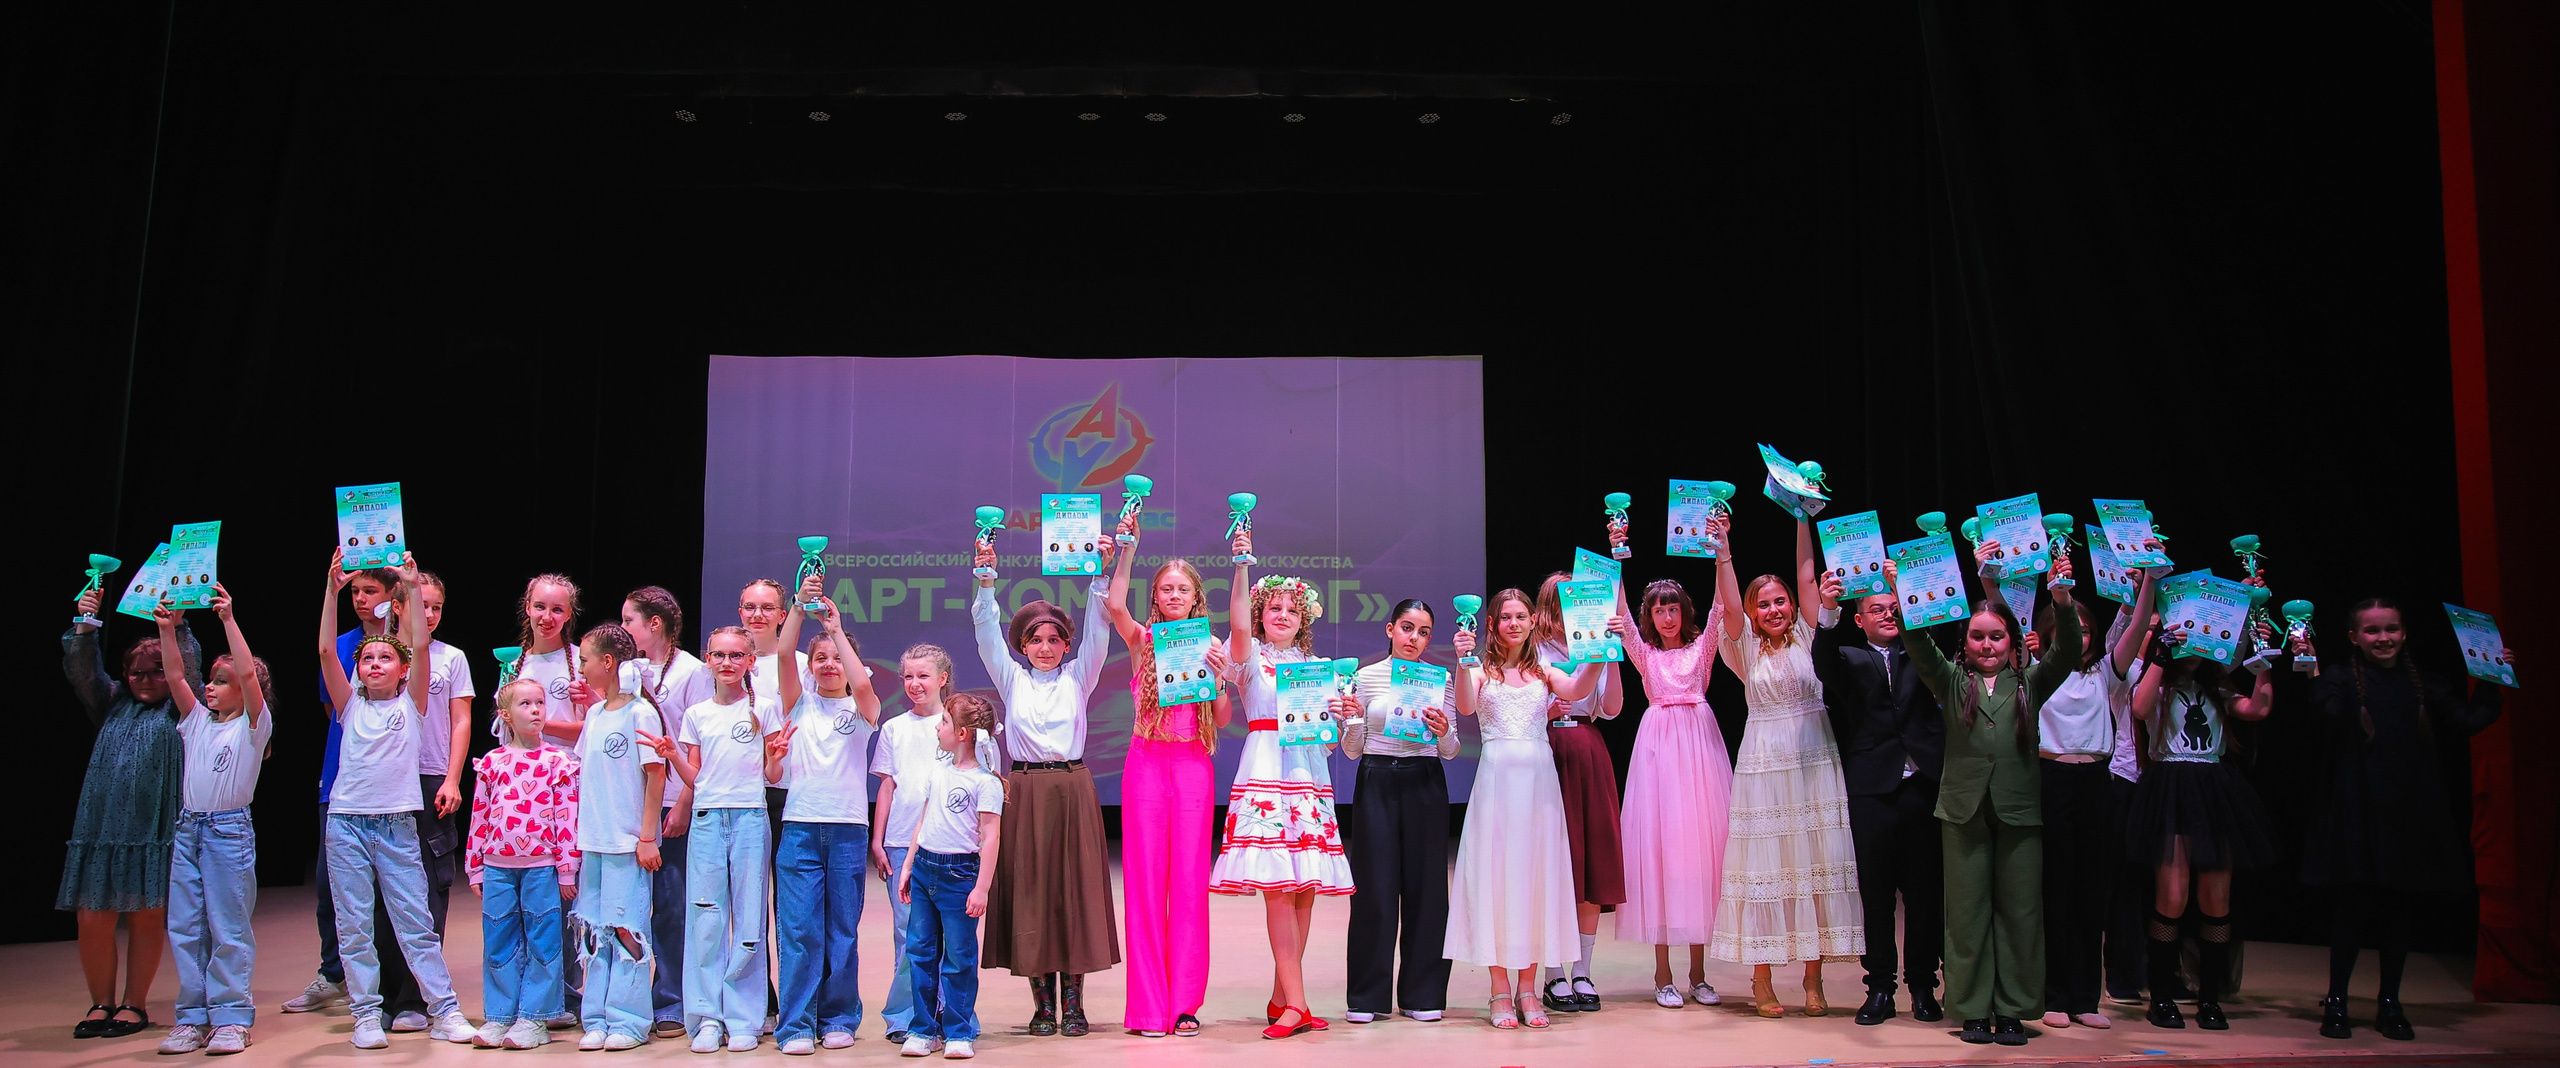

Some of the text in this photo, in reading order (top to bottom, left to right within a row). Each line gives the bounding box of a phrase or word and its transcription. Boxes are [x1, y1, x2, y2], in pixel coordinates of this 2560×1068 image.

[352, 502, 388, 513] ДИПЛОМ
[1055, 511, 1089, 520] ДИПЛОМ
[1994, 513, 2029, 528] ДИПЛОМ
[1834, 531, 1869, 544] ДИПЛОМ
[824, 551, 971, 568] ВСЕРОССИЙСКИЙ
[1257, 556, 1354, 568] ИСКУССТВА
[1906, 554, 1942, 571] ДИПЛОМ
[2199, 591, 2237, 608] ДИПЛОМ
[1166, 638, 1199, 650] ДИПЛОМ
[1289, 680, 1323, 690] ДИПЛОМ
